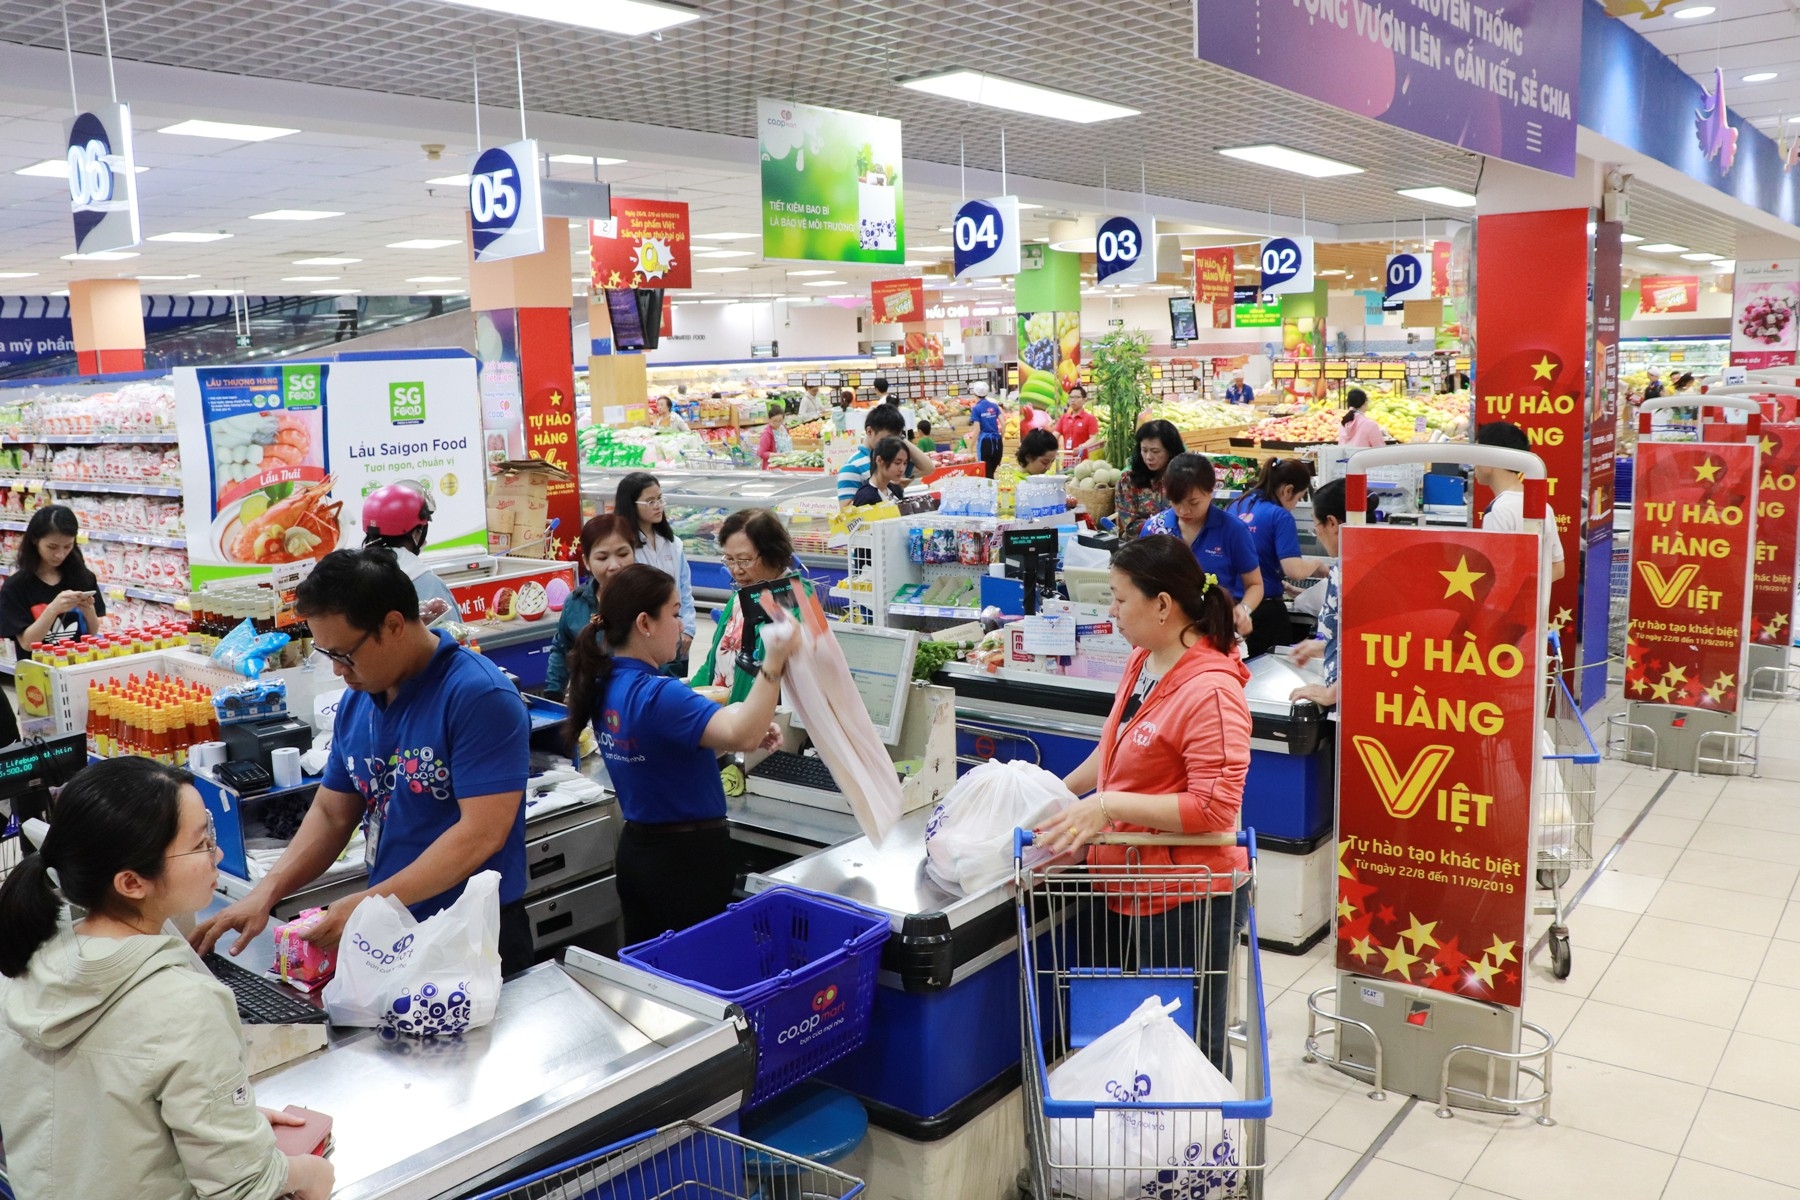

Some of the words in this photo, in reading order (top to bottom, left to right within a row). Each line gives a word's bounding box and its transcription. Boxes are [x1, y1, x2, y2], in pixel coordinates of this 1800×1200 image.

[1473, 7, 1524, 56] THỐNG
[1293, 0, 1348, 29] ỌNG
[1410, 22, 1442, 71] LÊN
[1454, 38, 1486, 89] GẮN
[1489, 59, 1519, 107] KẾT,
[1521, 68, 1539, 109] SẺ
[1540, 83, 1572, 121] CHIA
[68, 139, 109, 205] 06
[471, 168, 516, 223] 05
[769, 199, 785, 211] TIẾT
[786, 201, 805, 214] KIỆM
[805, 204, 821, 215] BAO
[822, 205, 830, 216] BÌ
[630, 218, 643, 228] Sản
[661, 220, 675, 231] Việt
[769, 216, 779, 226] LÀ
[780, 217, 796, 227] BẢO
[797, 218, 807, 229] VỆ
[808, 218, 822, 230] MÔI
[823, 220, 855, 233] TRƯỜNG
[955, 214, 998, 252] 04
[1099, 229, 1138, 262] 03
[1262, 248, 1297, 275] 02
[1389, 263, 1416, 285] 01
[9, 338, 33, 355] mỹ
[288, 374, 317, 392] SG
[288, 390, 317, 402] FOOD
[394, 386, 421, 406] SG
[393, 404, 422, 417] FOOD
[1485, 393, 1514, 419] TỰ
[1519, 389, 1575, 415] HÀO
[529, 413, 543, 430] TỰ
[545, 411, 572, 427] HÀO
[349, 440, 376, 459] Lẩu
[380, 442, 428, 457] Saigon
[433, 436, 468, 451] Food
[533, 431, 569, 446] HÀNG
[1759, 469, 1797, 491] ÀO
[1644, 500, 1677, 527] TỰ
[1682, 499, 1744, 526] HÀO
[1757, 501, 1786, 519] NG
[1651, 530, 1731, 558] HÀNG
[1756, 539, 1779, 565] ỆT
[1636, 560, 1723, 615] VIỆT
[1632, 618, 1646, 630] Tự
[1646, 619, 1667, 632] hào
[1669, 621, 1687, 634] tạo
[1688, 621, 1715, 635] khác
[1716, 623, 1739, 638] biệt
[1645, 634, 1662, 643] ngày
[1680, 636, 1695, 645] đến
[1361, 632, 1412, 678] TỰ
[1424, 630, 1524, 678] HÀO
[1375, 685, 1505, 736] HÀNG
[1352, 734, 1494, 833] VIỆT
[1347, 834, 1370, 853] Tự
[1372, 836, 1403, 857] hào
[1407, 844, 1436, 862] tạo
[1440, 848, 1481, 871] khác
[1485, 856, 1522, 877] biệt
[1354, 858, 1369, 870] Từ
[1370, 863, 1397, 877] ngày
[1398, 866, 1425, 880] 22/8
[1427, 869, 1449, 884] đến
[1451, 874, 1515, 895] 11/9/2019
